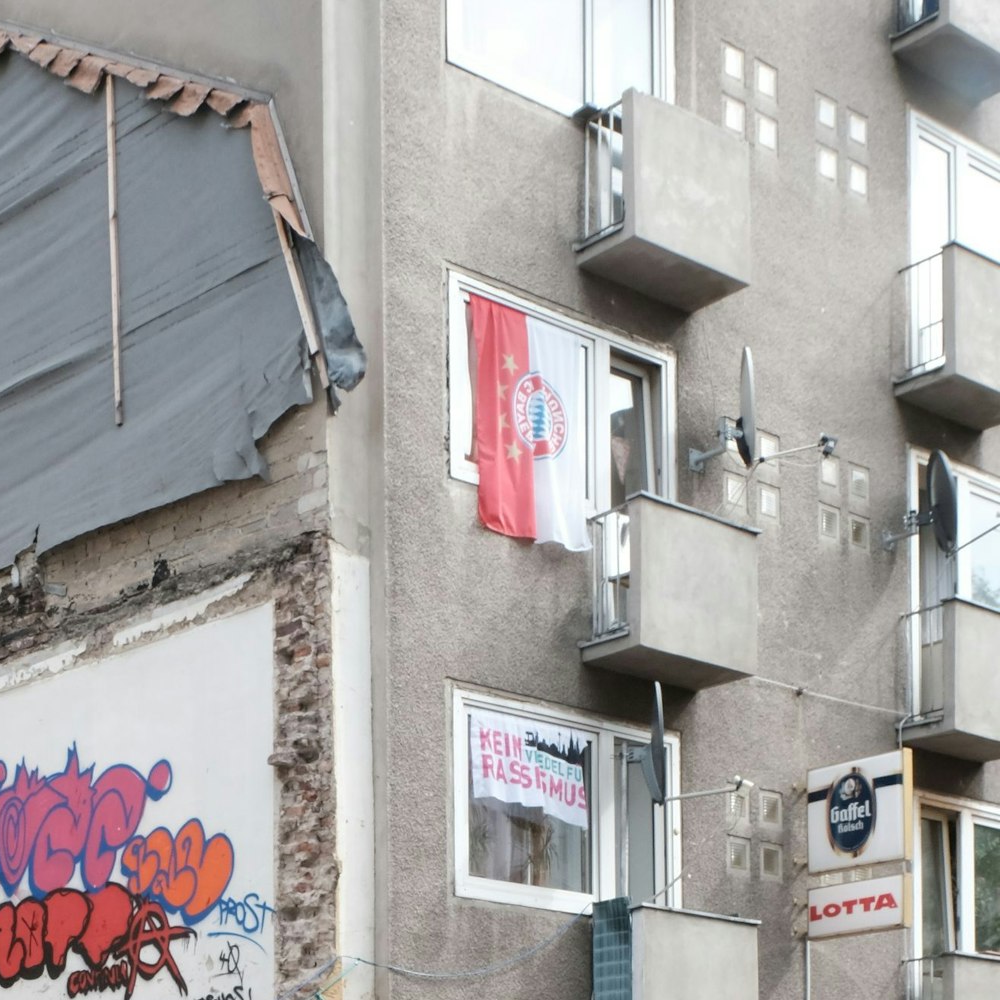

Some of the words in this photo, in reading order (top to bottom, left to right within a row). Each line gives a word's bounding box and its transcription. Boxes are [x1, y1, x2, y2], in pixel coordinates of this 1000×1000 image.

[480, 727, 522, 761] KEIN
[830, 800, 871, 823] Gaffel
[217, 893, 276, 934] PROST
[809, 893, 898, 922] LOTTA
